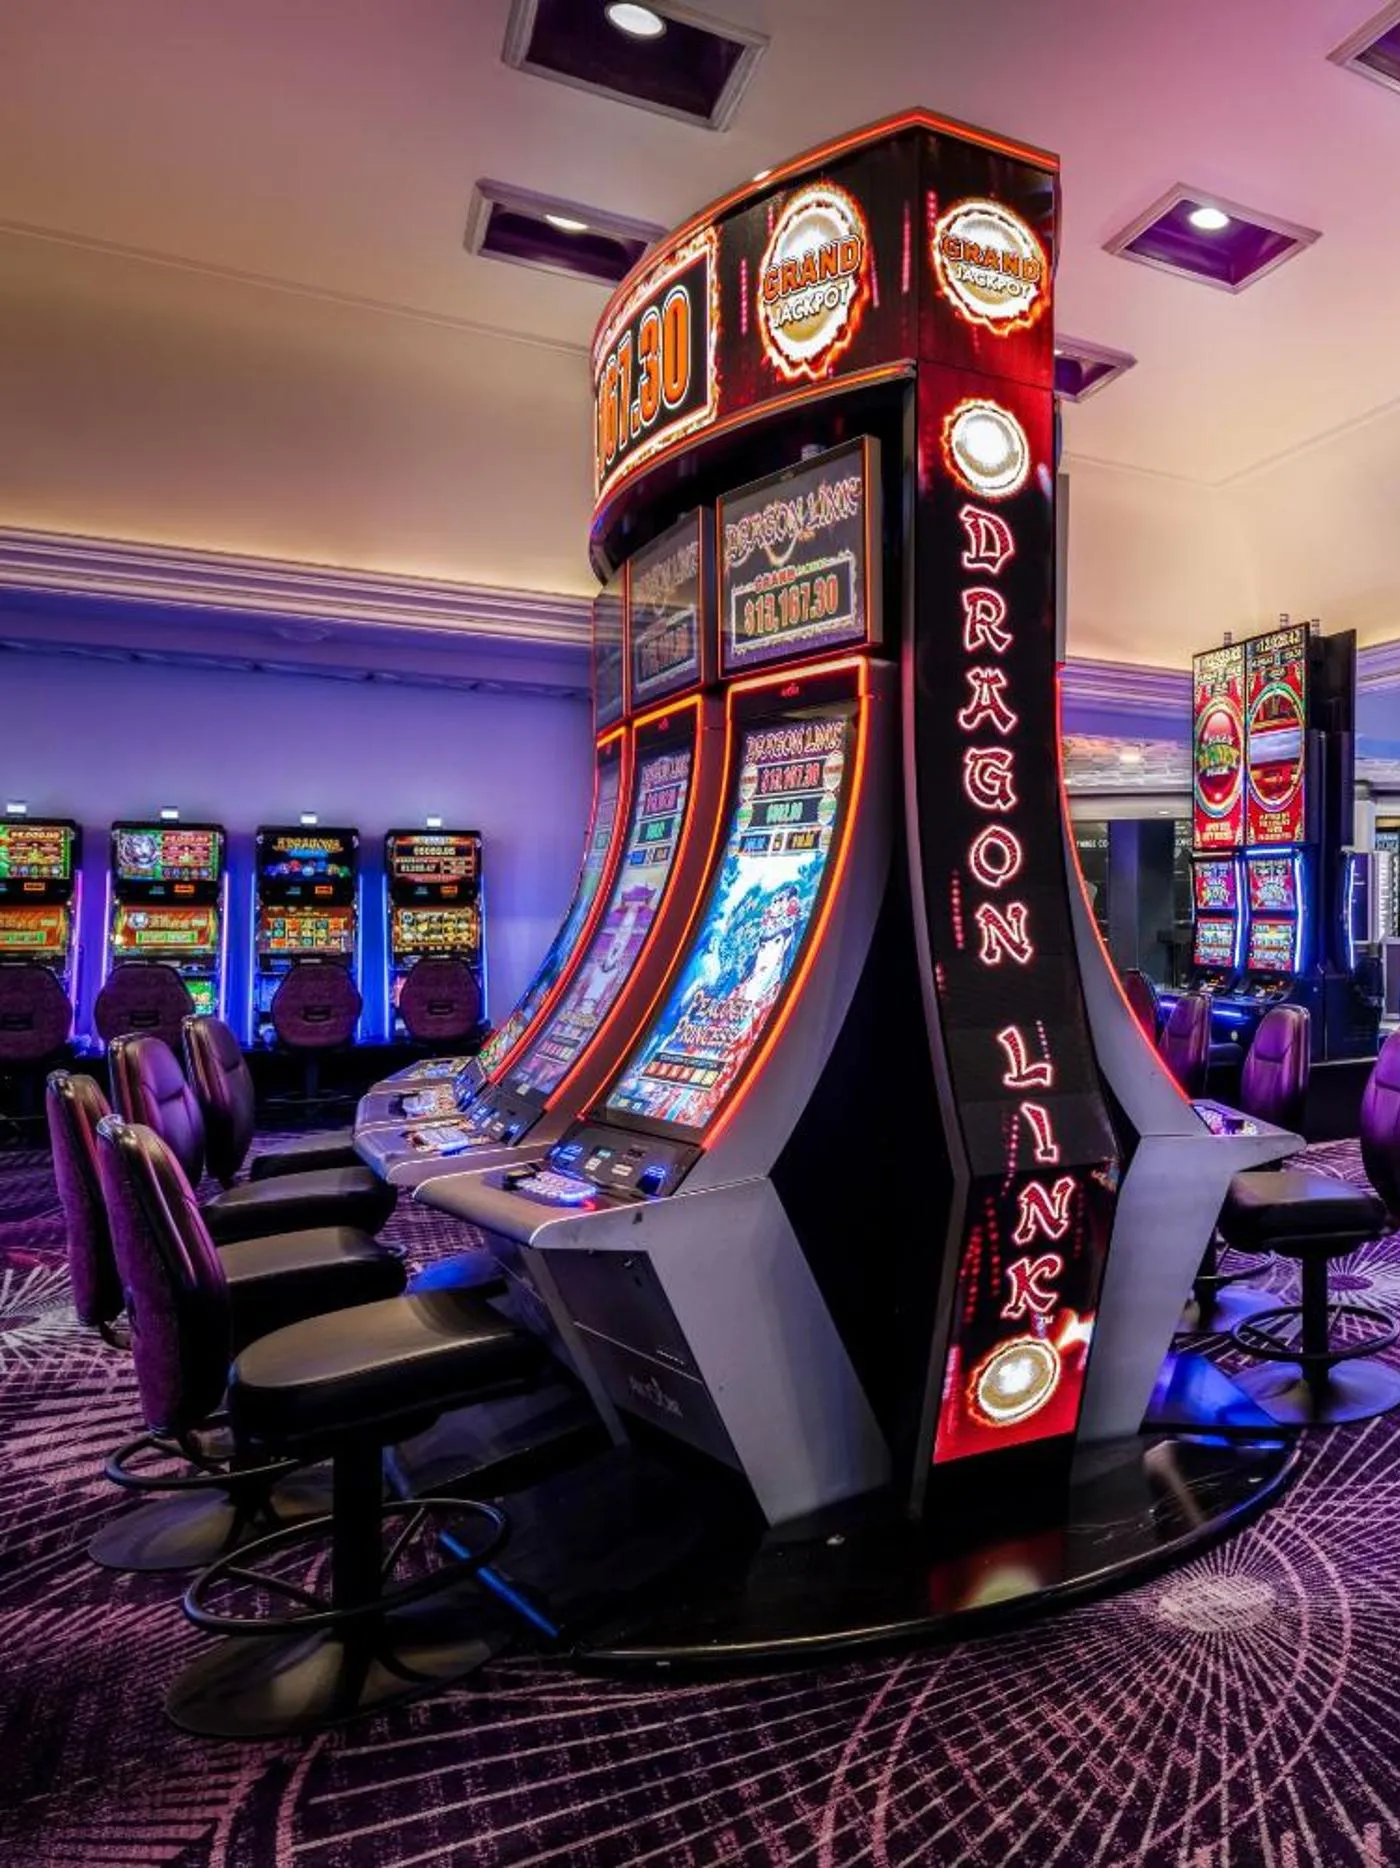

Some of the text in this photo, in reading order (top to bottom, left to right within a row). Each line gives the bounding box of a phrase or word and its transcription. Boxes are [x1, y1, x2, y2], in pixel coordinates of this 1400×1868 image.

[762, 233, 863, 305] GRAND
[939, 231, 1042, 283] GRAND
[953, 264, 1034, 301] JACKPOT
[768, 281, 850, 329] JACKPOT
[958, 503, 1034, 966] DRAGON
[996, 1025, 1075, 1321] LINK
